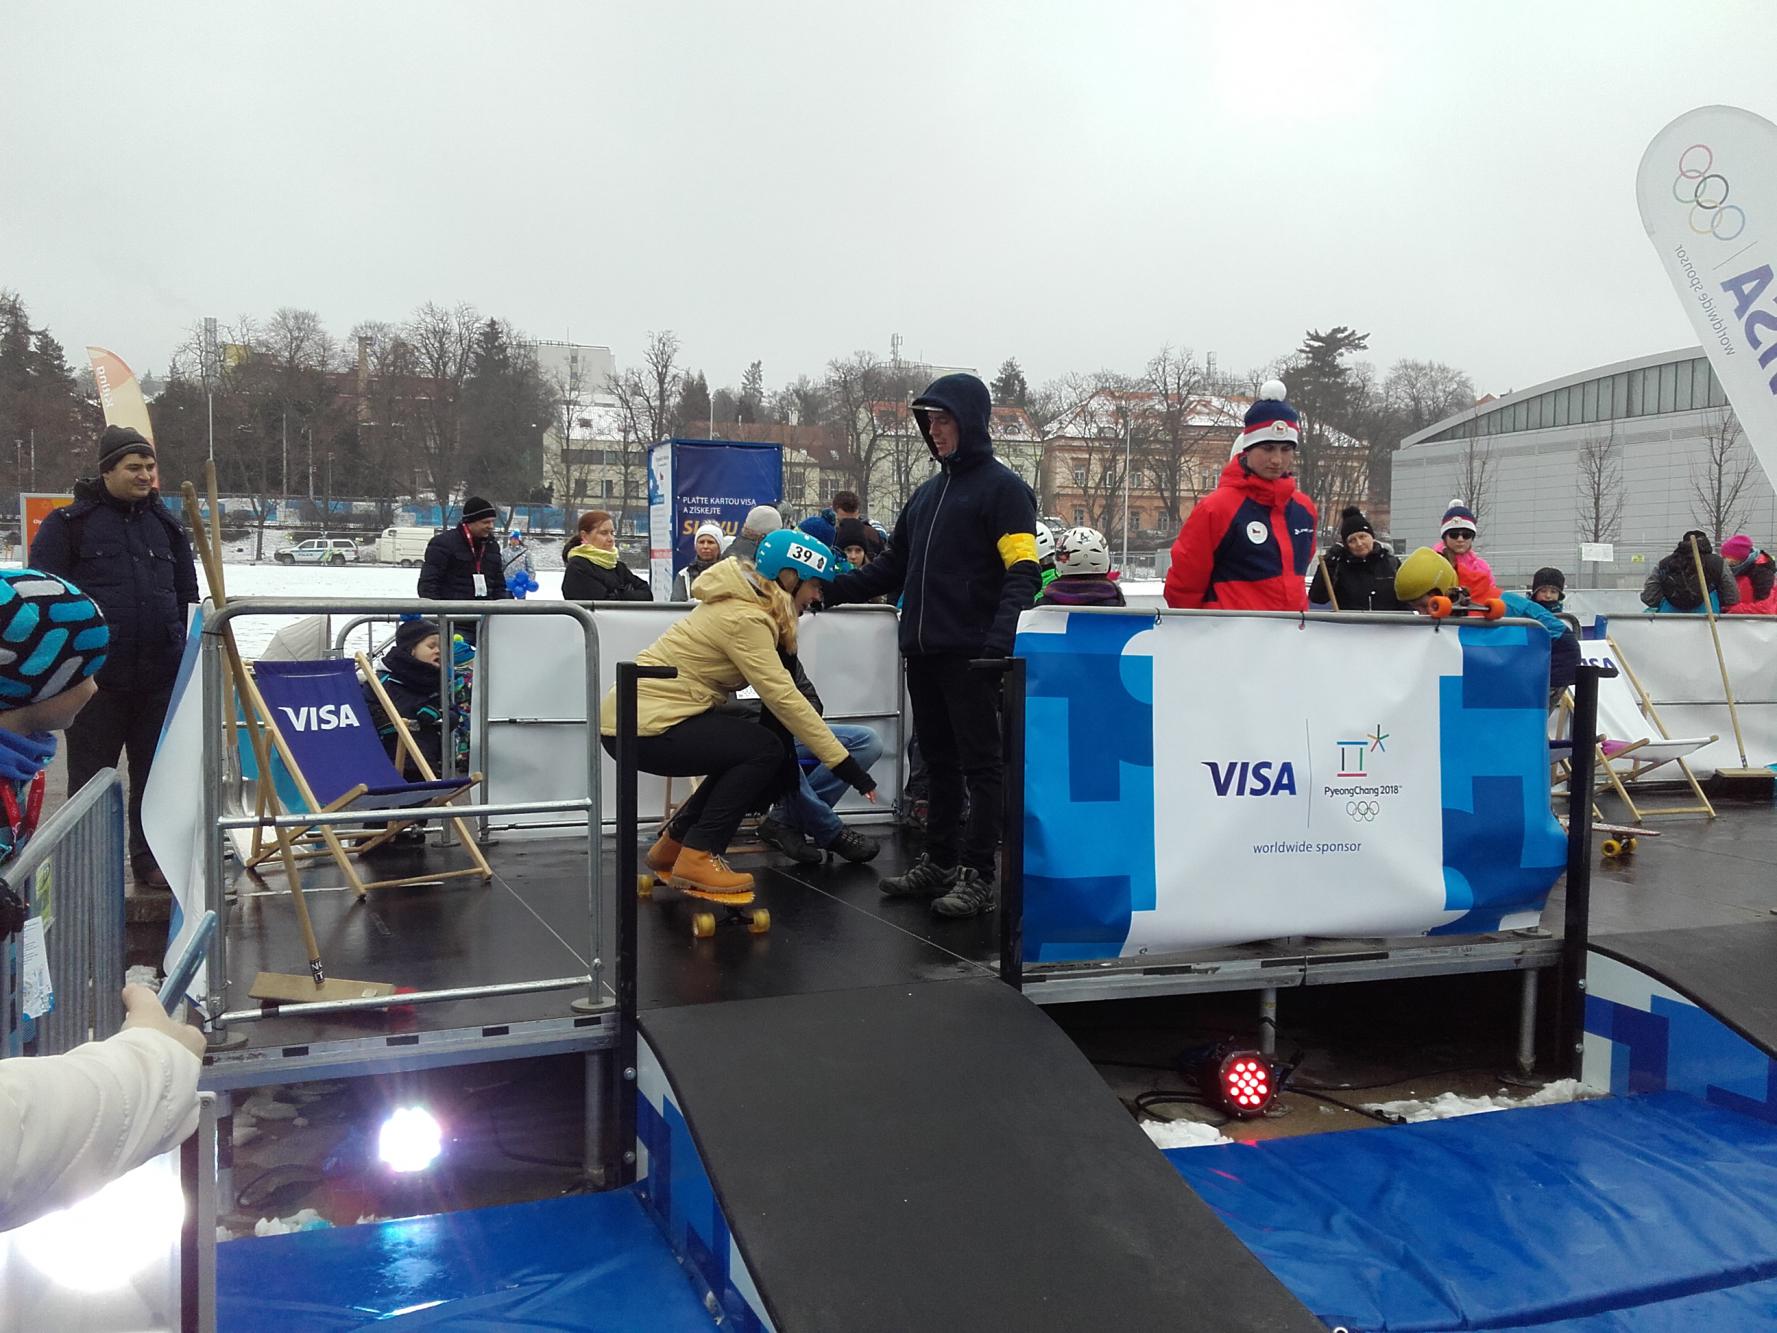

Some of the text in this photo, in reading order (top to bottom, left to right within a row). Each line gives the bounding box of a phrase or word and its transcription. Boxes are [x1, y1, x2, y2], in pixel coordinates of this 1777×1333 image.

[710, 497, 740, 506] KARTOU
[792, 546, 813, 563] 39
[278, 704, 361, 732] VISA
[1200, 761, 1297, 797] VISA
[1324, 786, 1379, 798] PyeongChang
[1253, 841, 1362, 855] worldwide sponsor
